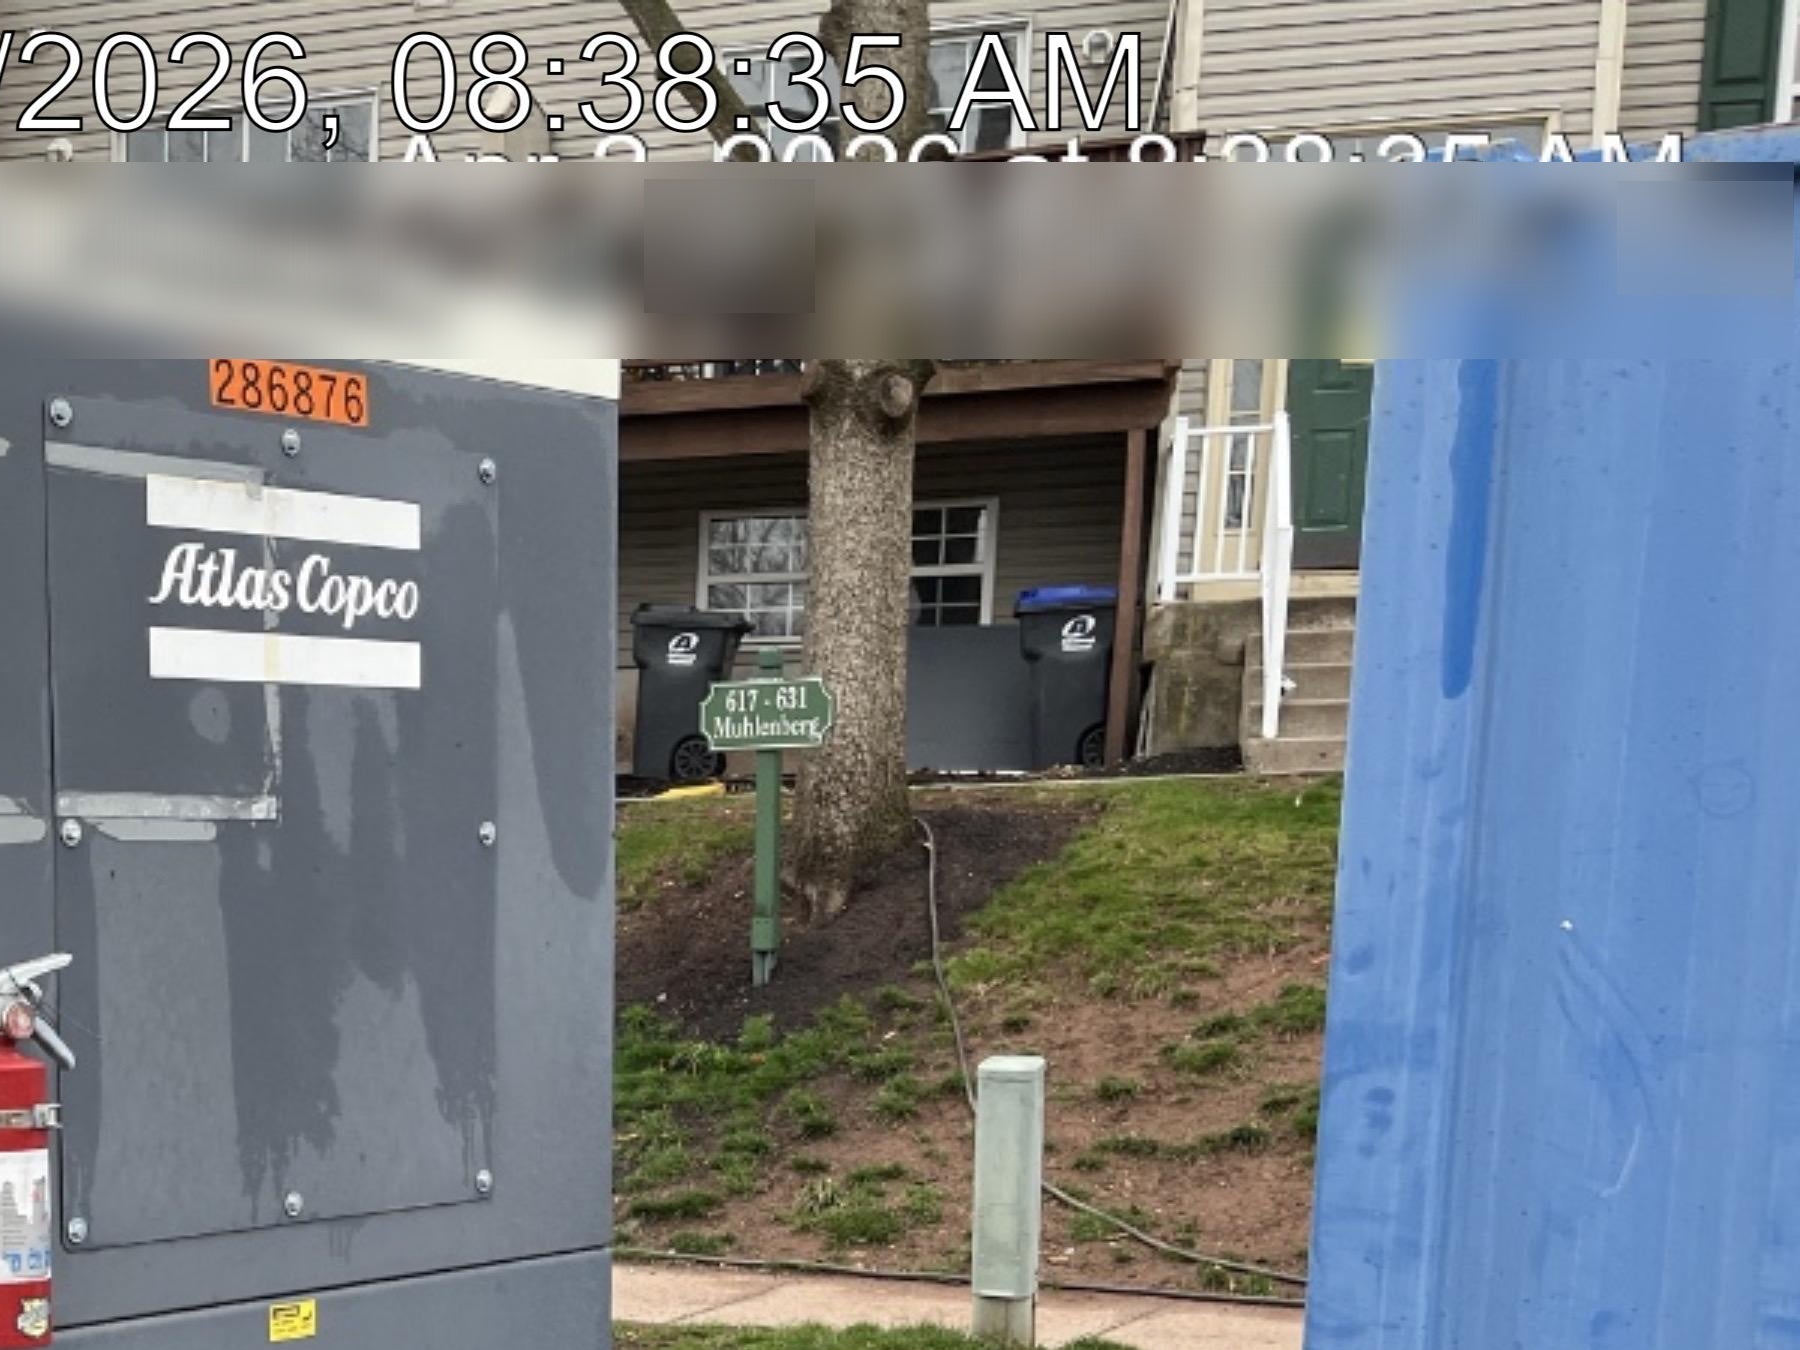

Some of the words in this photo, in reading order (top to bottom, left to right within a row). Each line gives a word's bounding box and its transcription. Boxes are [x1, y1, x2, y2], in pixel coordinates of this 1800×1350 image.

[213, 358, 365, 424] 286876
[148, 542, 292, 611] Atlas
[296, 553, 419, 630] Copco
[724, 688, 760, 713] 617
[776, 685, 808, 711] 631
[712, 714, 821, 742] Muhlenberg
